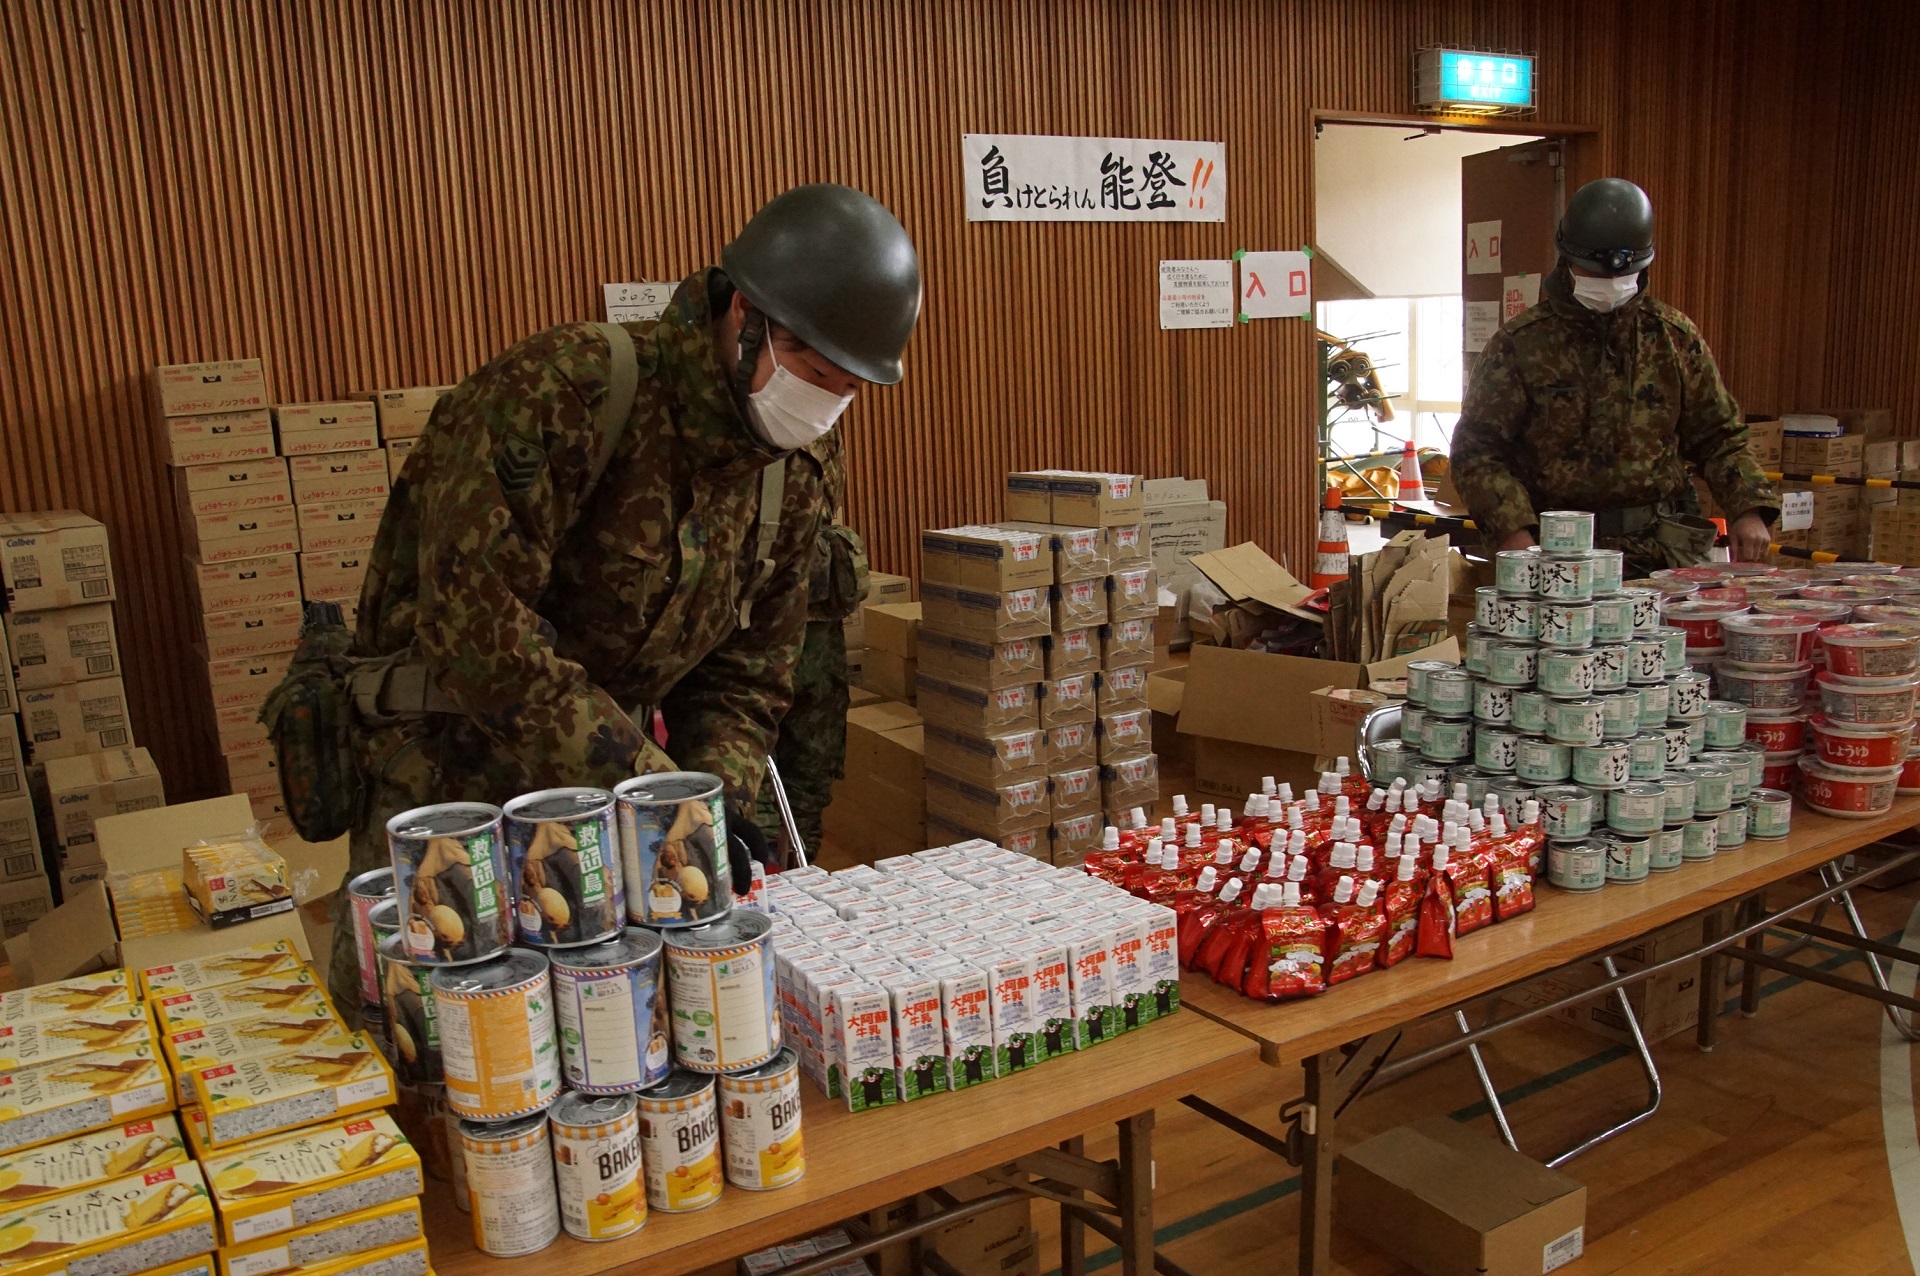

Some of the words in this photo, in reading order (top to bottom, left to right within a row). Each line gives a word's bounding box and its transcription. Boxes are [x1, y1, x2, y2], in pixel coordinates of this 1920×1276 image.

[1245, 271, 1307, 299] 入口
[6, 538, 36, 547] Calbee
[13, 615, 41, 625] Calbee
[1750, 730, 1786, 744] ょうゆ
[1825, 741, 1870, 758] しょうゆ
[59, 793, 89, 804] Calbee
[577, 824, 604, 894] 救缶鳥
[69, 872, 99, 884] Calbee
[470, 838, 496, 910] 救缶鳥
[1146, 927, 1176, 946] 大阿蘇
[1111, 939, 1141, 959] 大阿蘇
[1151, 941, 1170, 953] 牛乳
[1076, 951, 1107, 971] 大阿蘇
[1117, 953, 1136, 966] 牛乳
[1033, 963, 1066, 983] 大阿蘇
[1082, 965, 1101, 979] 牛乳
[995, 976, 1030, 996] 大阿蘇
[1040, 977, 1060, 990] 牛乳
[197, 992, 223, 1019] SUNAO
[951, 989, 987, 1009] 大阿蘇
[1002, 991, 1023, 1004] 牛乳
[901, 998, 939, 1019] 大阿蘇
[957, 1003, 980, 1017] 牛乳
[847, 1010, 889, 1029] 大阿蘇
[909, 1013, 932, 1027] 牛乳
[856, 1025, 881, 1037] 牛乳
[18, 1025, 39, 1058] SUNAO
[208, 1027, 237, 1056] SUNAO
[240, 1062, 272, 1096] SUNAO
[18, 1072, 43, 1106] SUNAO
[265, 1137, 346, 1166] SUNAO
[49, 1190, 140, 1219] SUNAO
